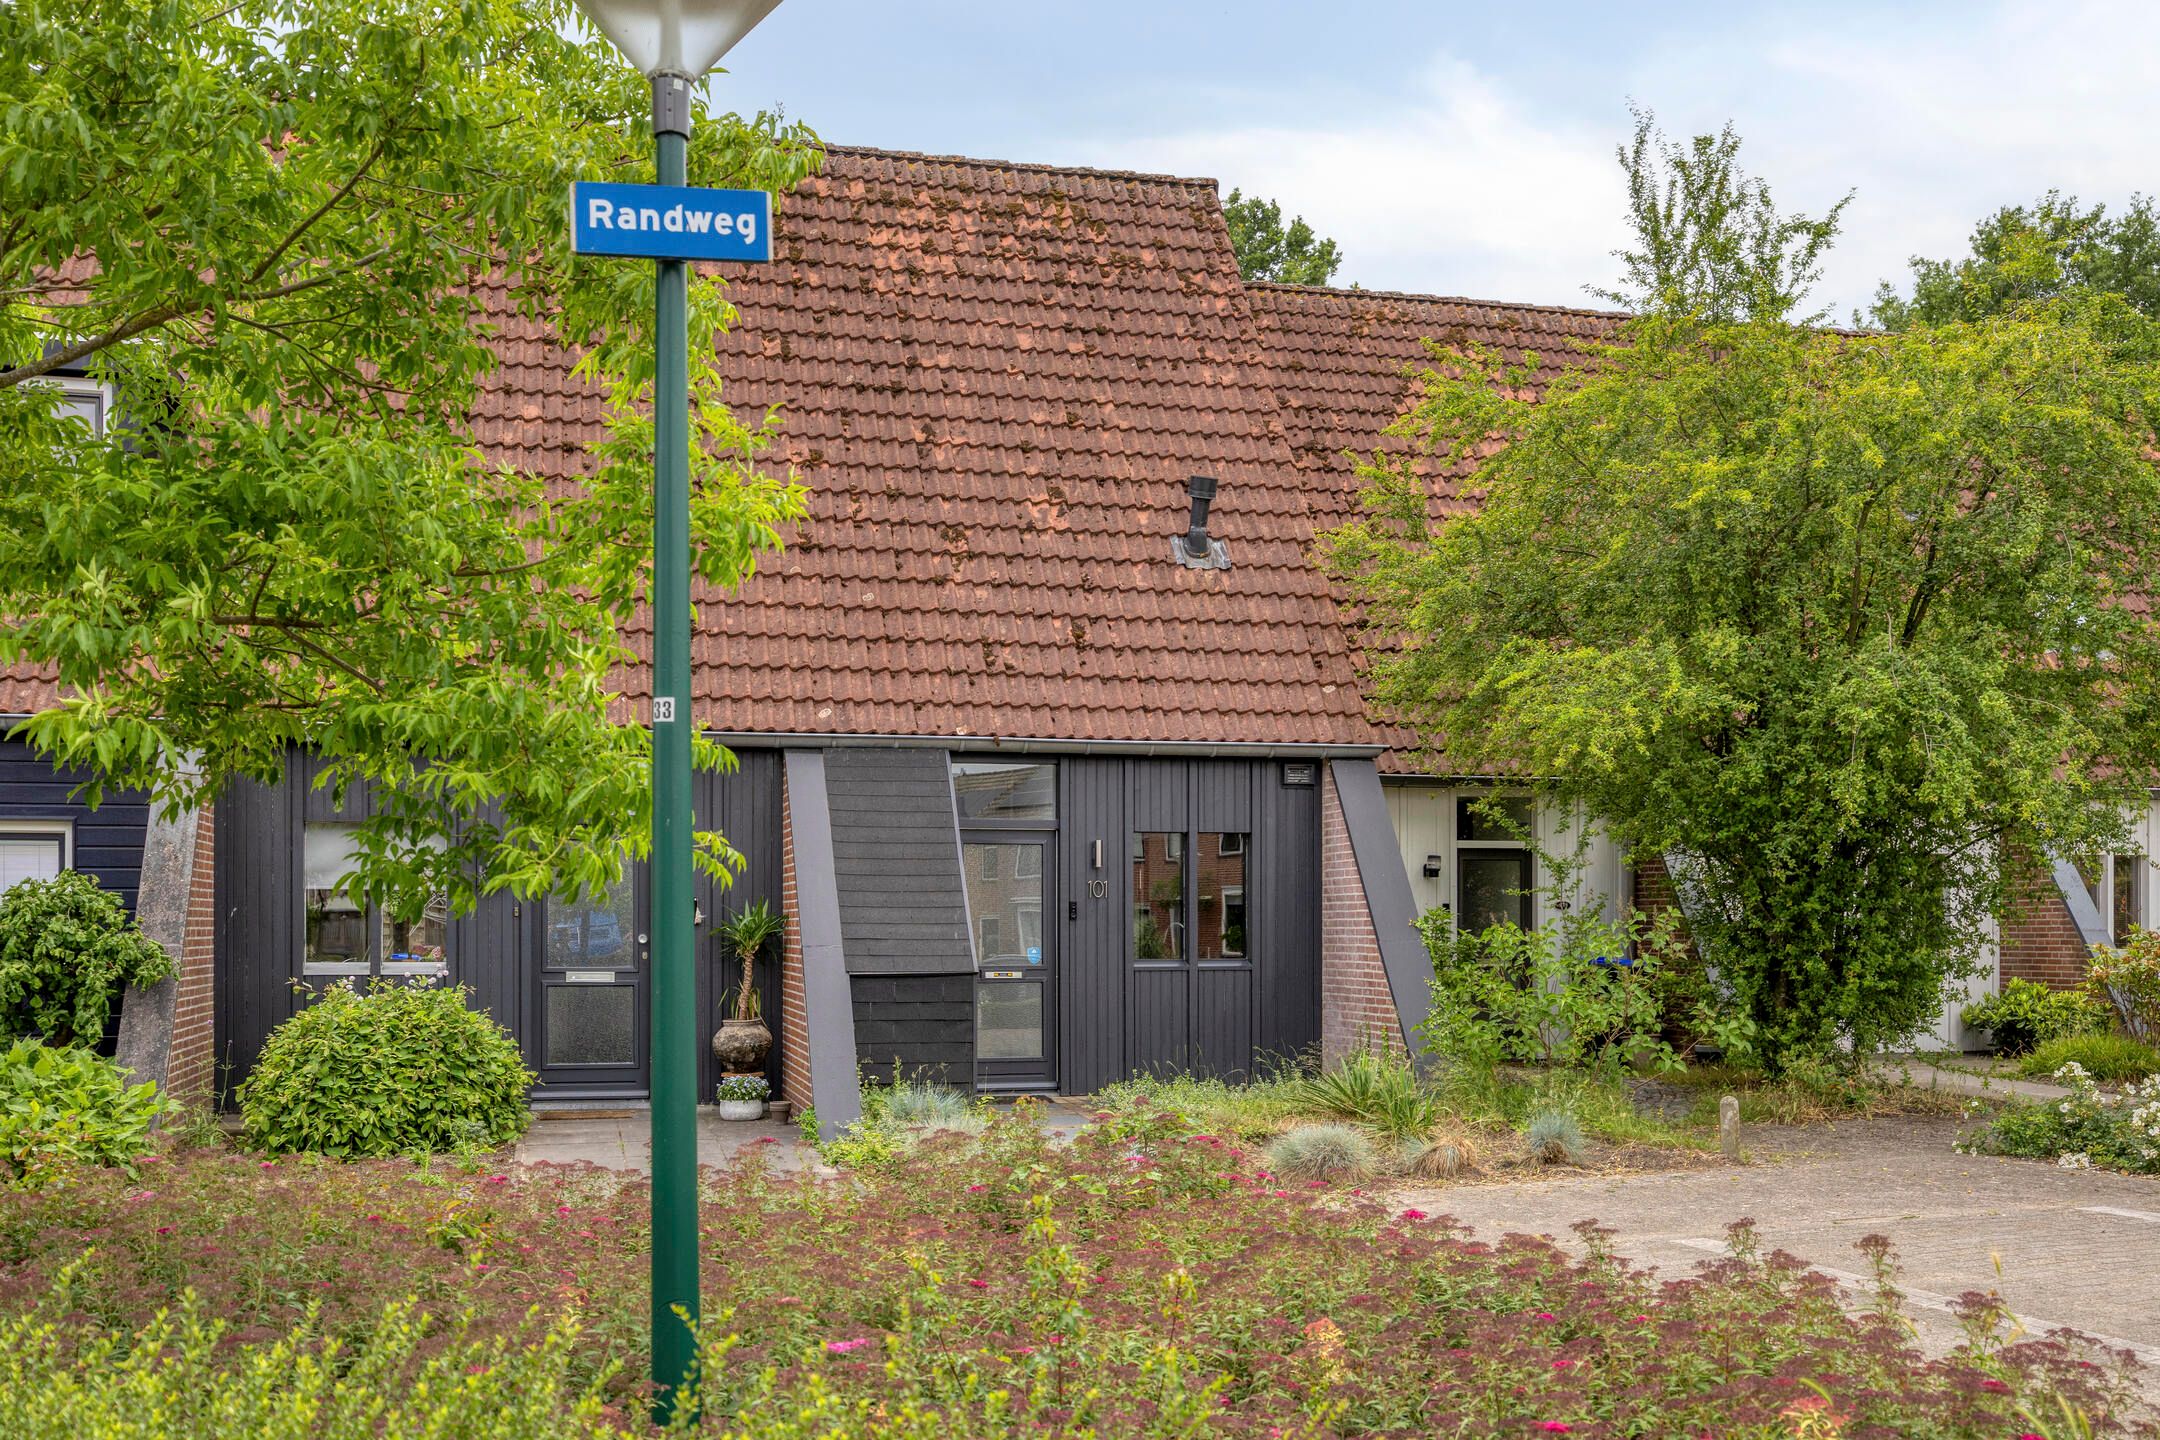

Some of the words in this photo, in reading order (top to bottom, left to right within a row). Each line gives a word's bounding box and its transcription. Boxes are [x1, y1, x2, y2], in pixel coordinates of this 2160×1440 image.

[588, 198, 756, 245] Randweg
[654, 701, 671, 719] 33
[1087, 880, 1108, 898] 101
